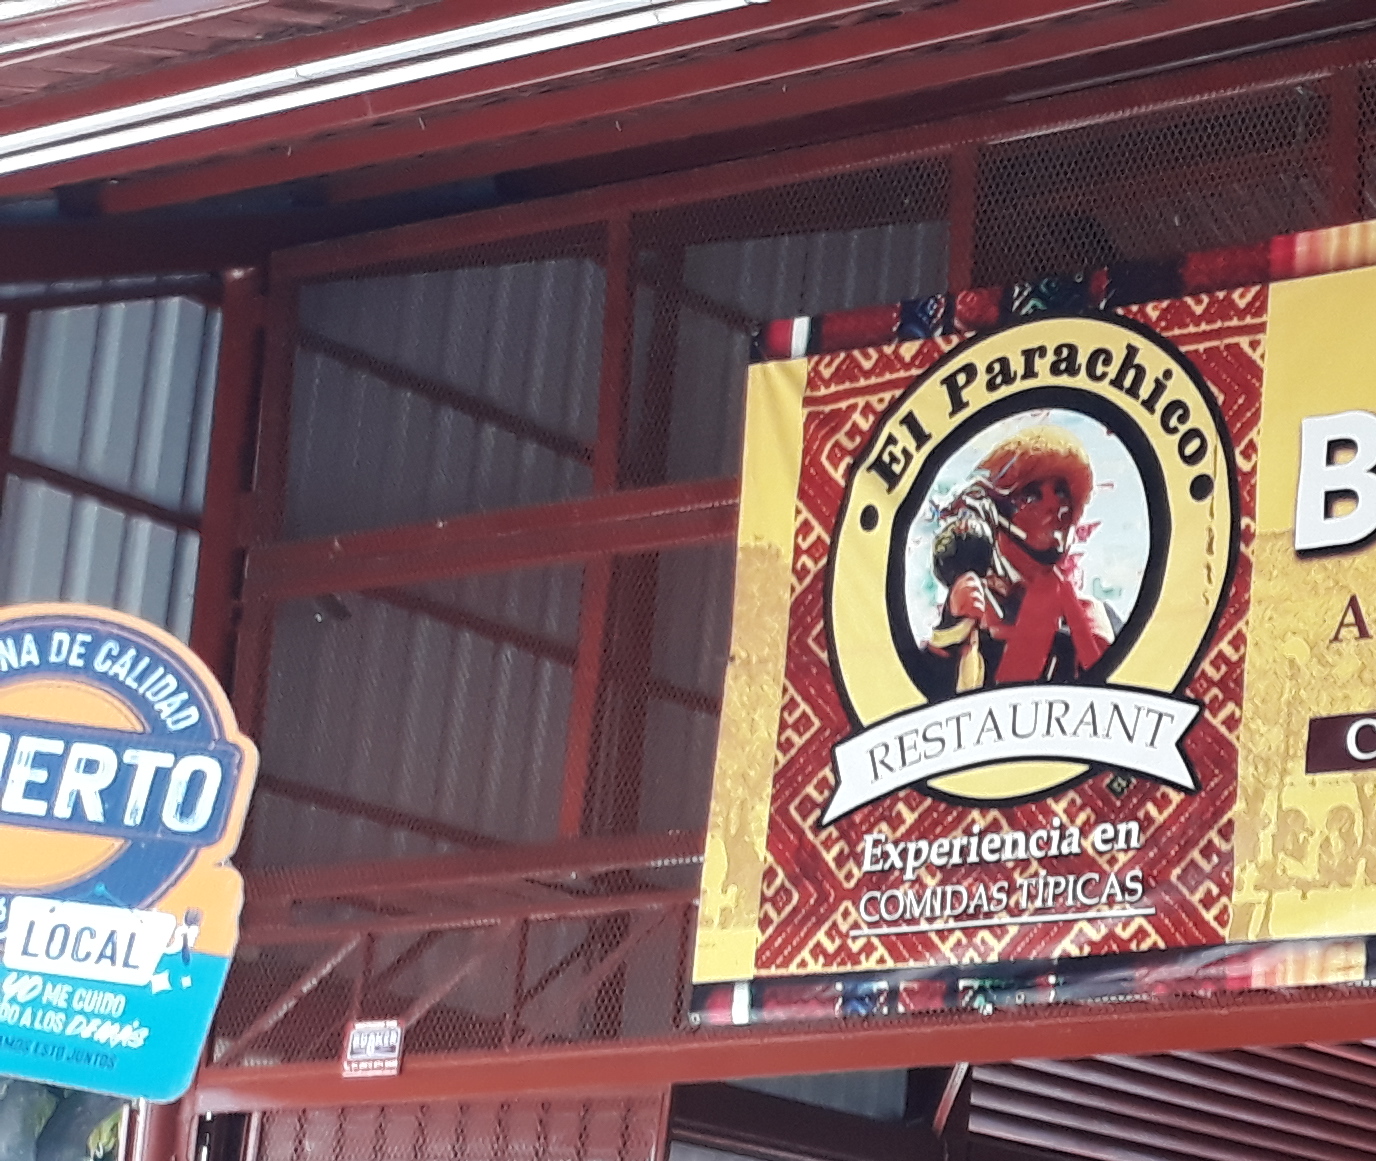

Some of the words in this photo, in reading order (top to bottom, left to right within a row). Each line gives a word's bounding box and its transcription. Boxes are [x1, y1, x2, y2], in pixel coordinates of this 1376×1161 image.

[866, 416, 932, 495] El
[940, 343, 1210, 466] Parachico
[1328, 593, 1372, 645] A
[49, 631, 93, 668] DE
[93, 639, 200, 732] CALIDAD
[865, 698, 1175, 784] RESTAURANT
[861, 817, 1082, 881] Experiencia
[1093, 819, 1142, 852] en
[859, 880, 1009, 923] COMIDAS
[1016, 868, 1144, 910] TÍPICAS
[21, 919, 140, 970] LOCAL
[2, 971, 43, 1003] YO
[42, 980, 73, 1009] ME
[72, 987, 126, 1018] CUIDO
[20, 1006, 33, 1029] A
[34, 1008, 66, 1034] LOS
[66, 1049, 116, 1069] JUNTOS
